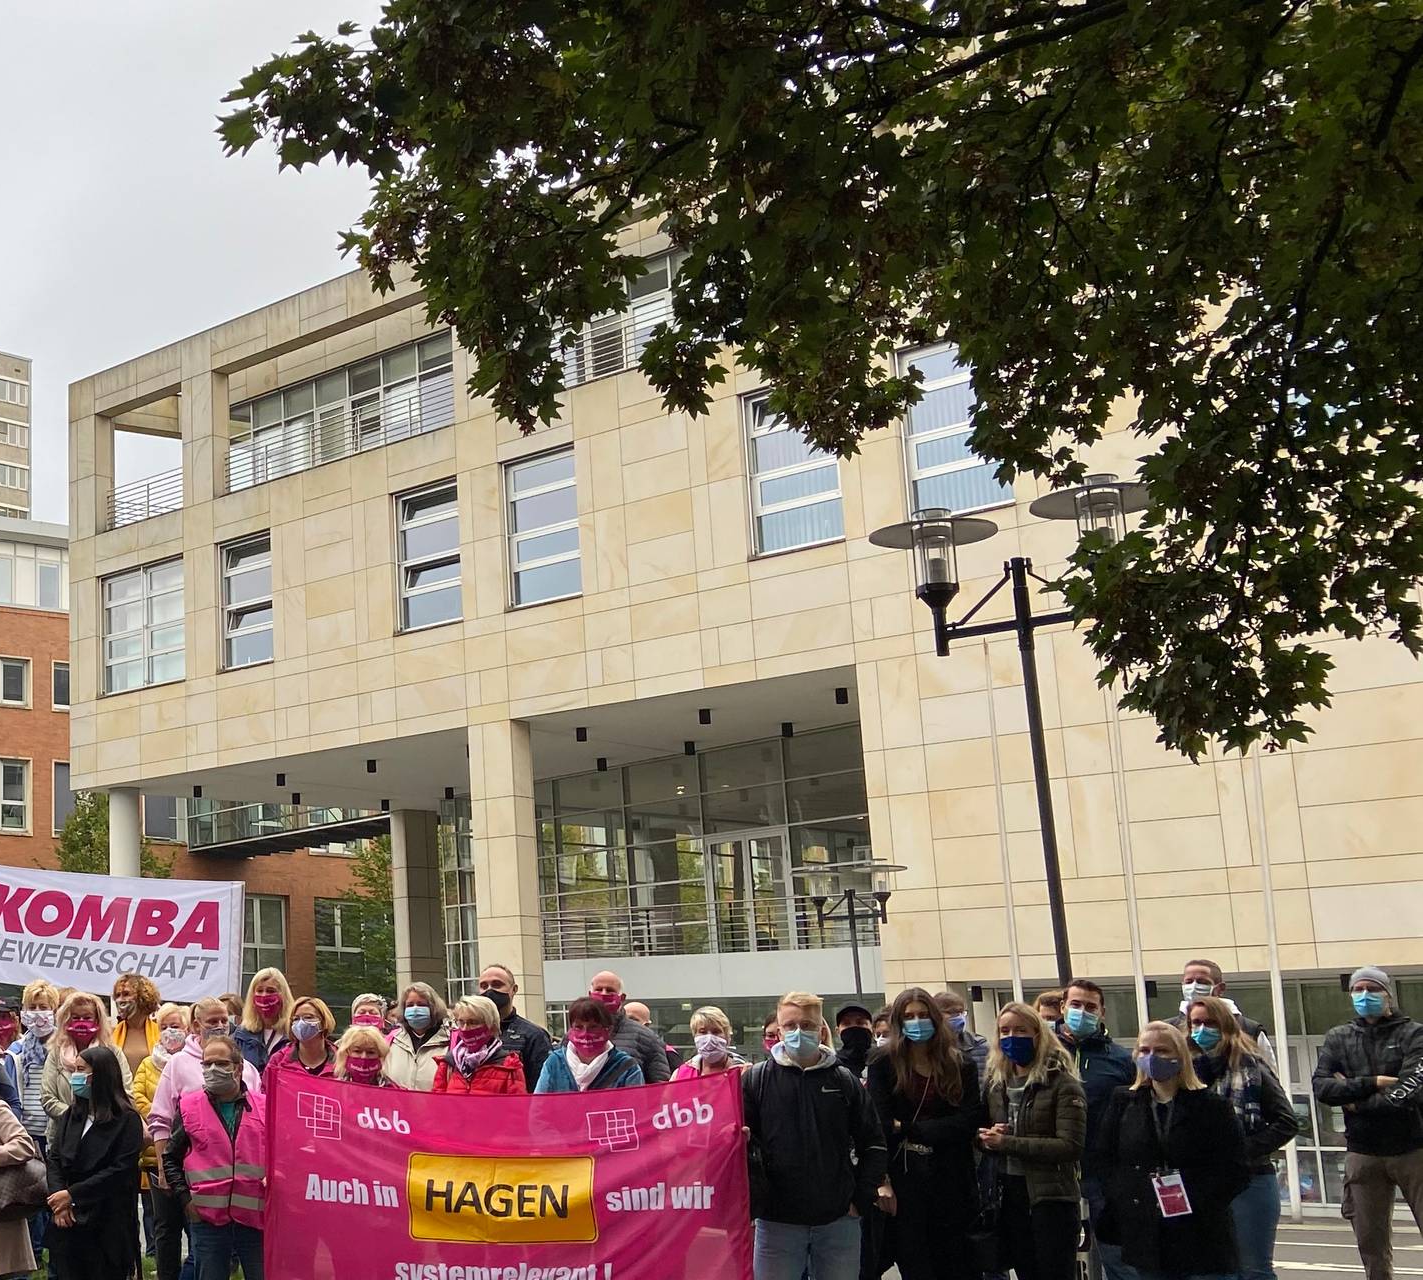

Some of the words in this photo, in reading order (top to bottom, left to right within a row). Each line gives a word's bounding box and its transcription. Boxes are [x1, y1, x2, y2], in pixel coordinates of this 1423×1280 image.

[357, 1106, 411, 1135] dbb
[652, 1097, 714, 1130] dbb
[305, 1173, 370, 1206] Auch
[373, 1180, 399, 1208] in
[425, 1178, 570, 1219] HAGEN
[606, 1182, 665, 1212] sind
[671, 1181, 715, 1210] wir
